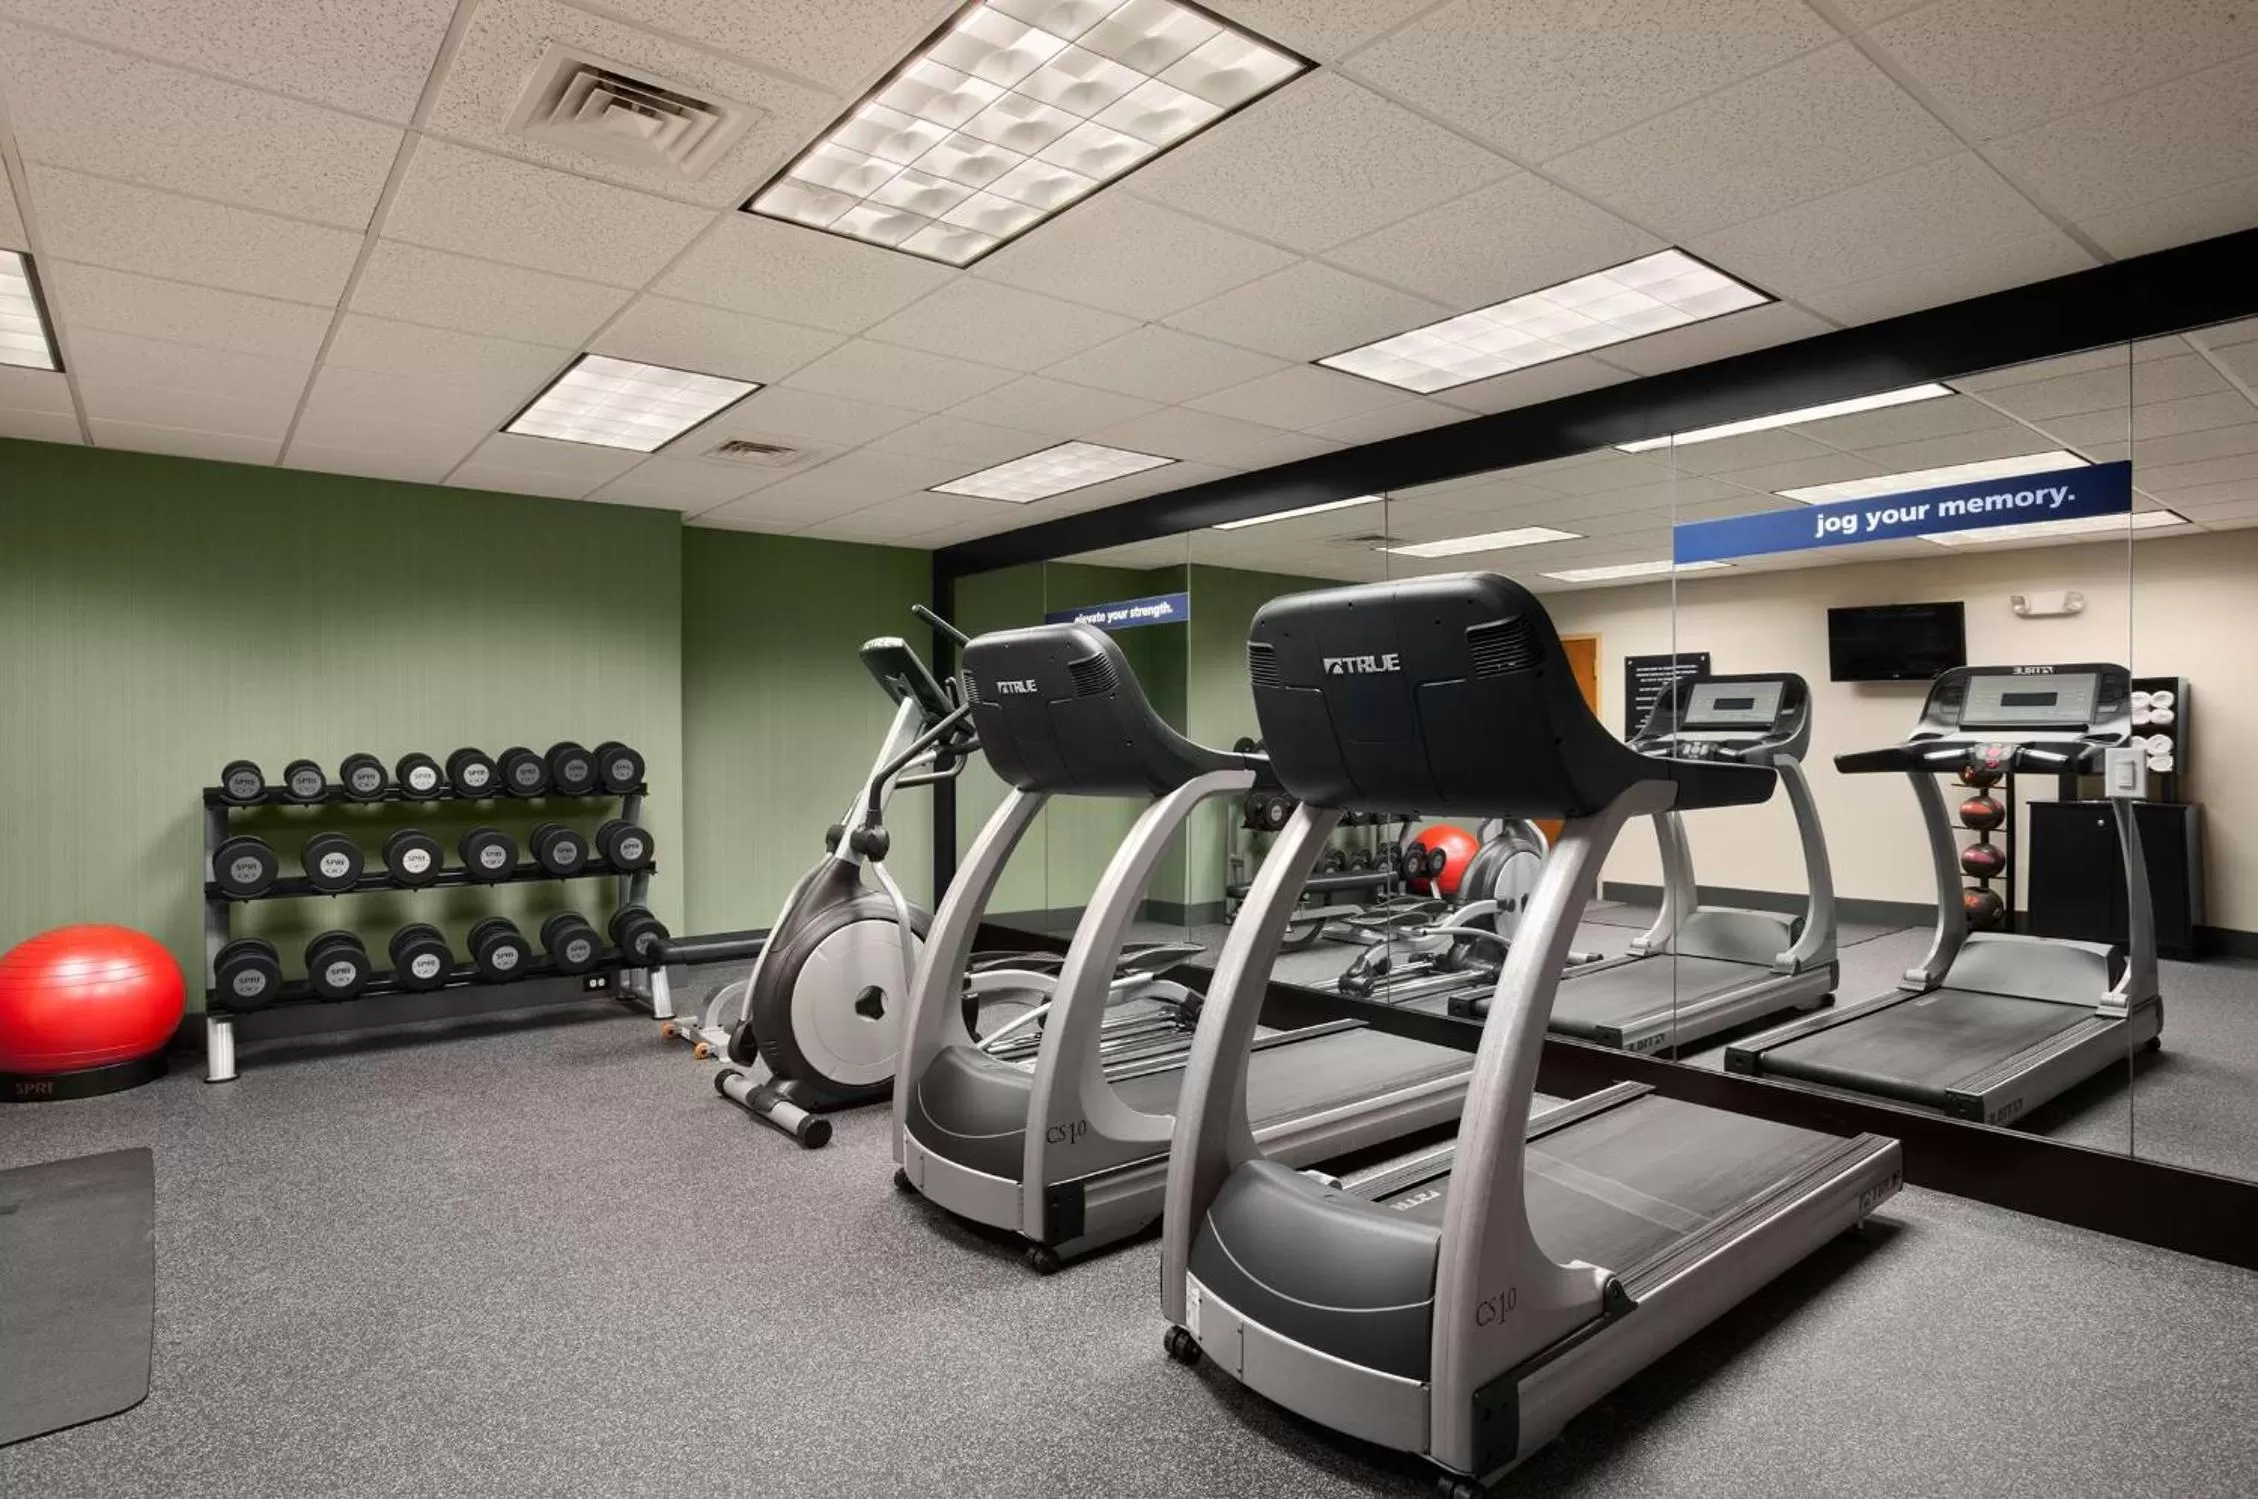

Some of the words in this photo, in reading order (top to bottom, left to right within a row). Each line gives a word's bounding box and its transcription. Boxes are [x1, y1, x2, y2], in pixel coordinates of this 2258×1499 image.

[1814, 513, 1858, 538] jog
[1865, 503, 1930, 531] your
[1938, 485, 2075, 518] memory.
[1107, 608, 1128, 624] your
[1130, 601, 1173, 618] strength.
[1342, 654, 1400, 674] TRUE
[1007, 679, 1037, 693] TRUE
